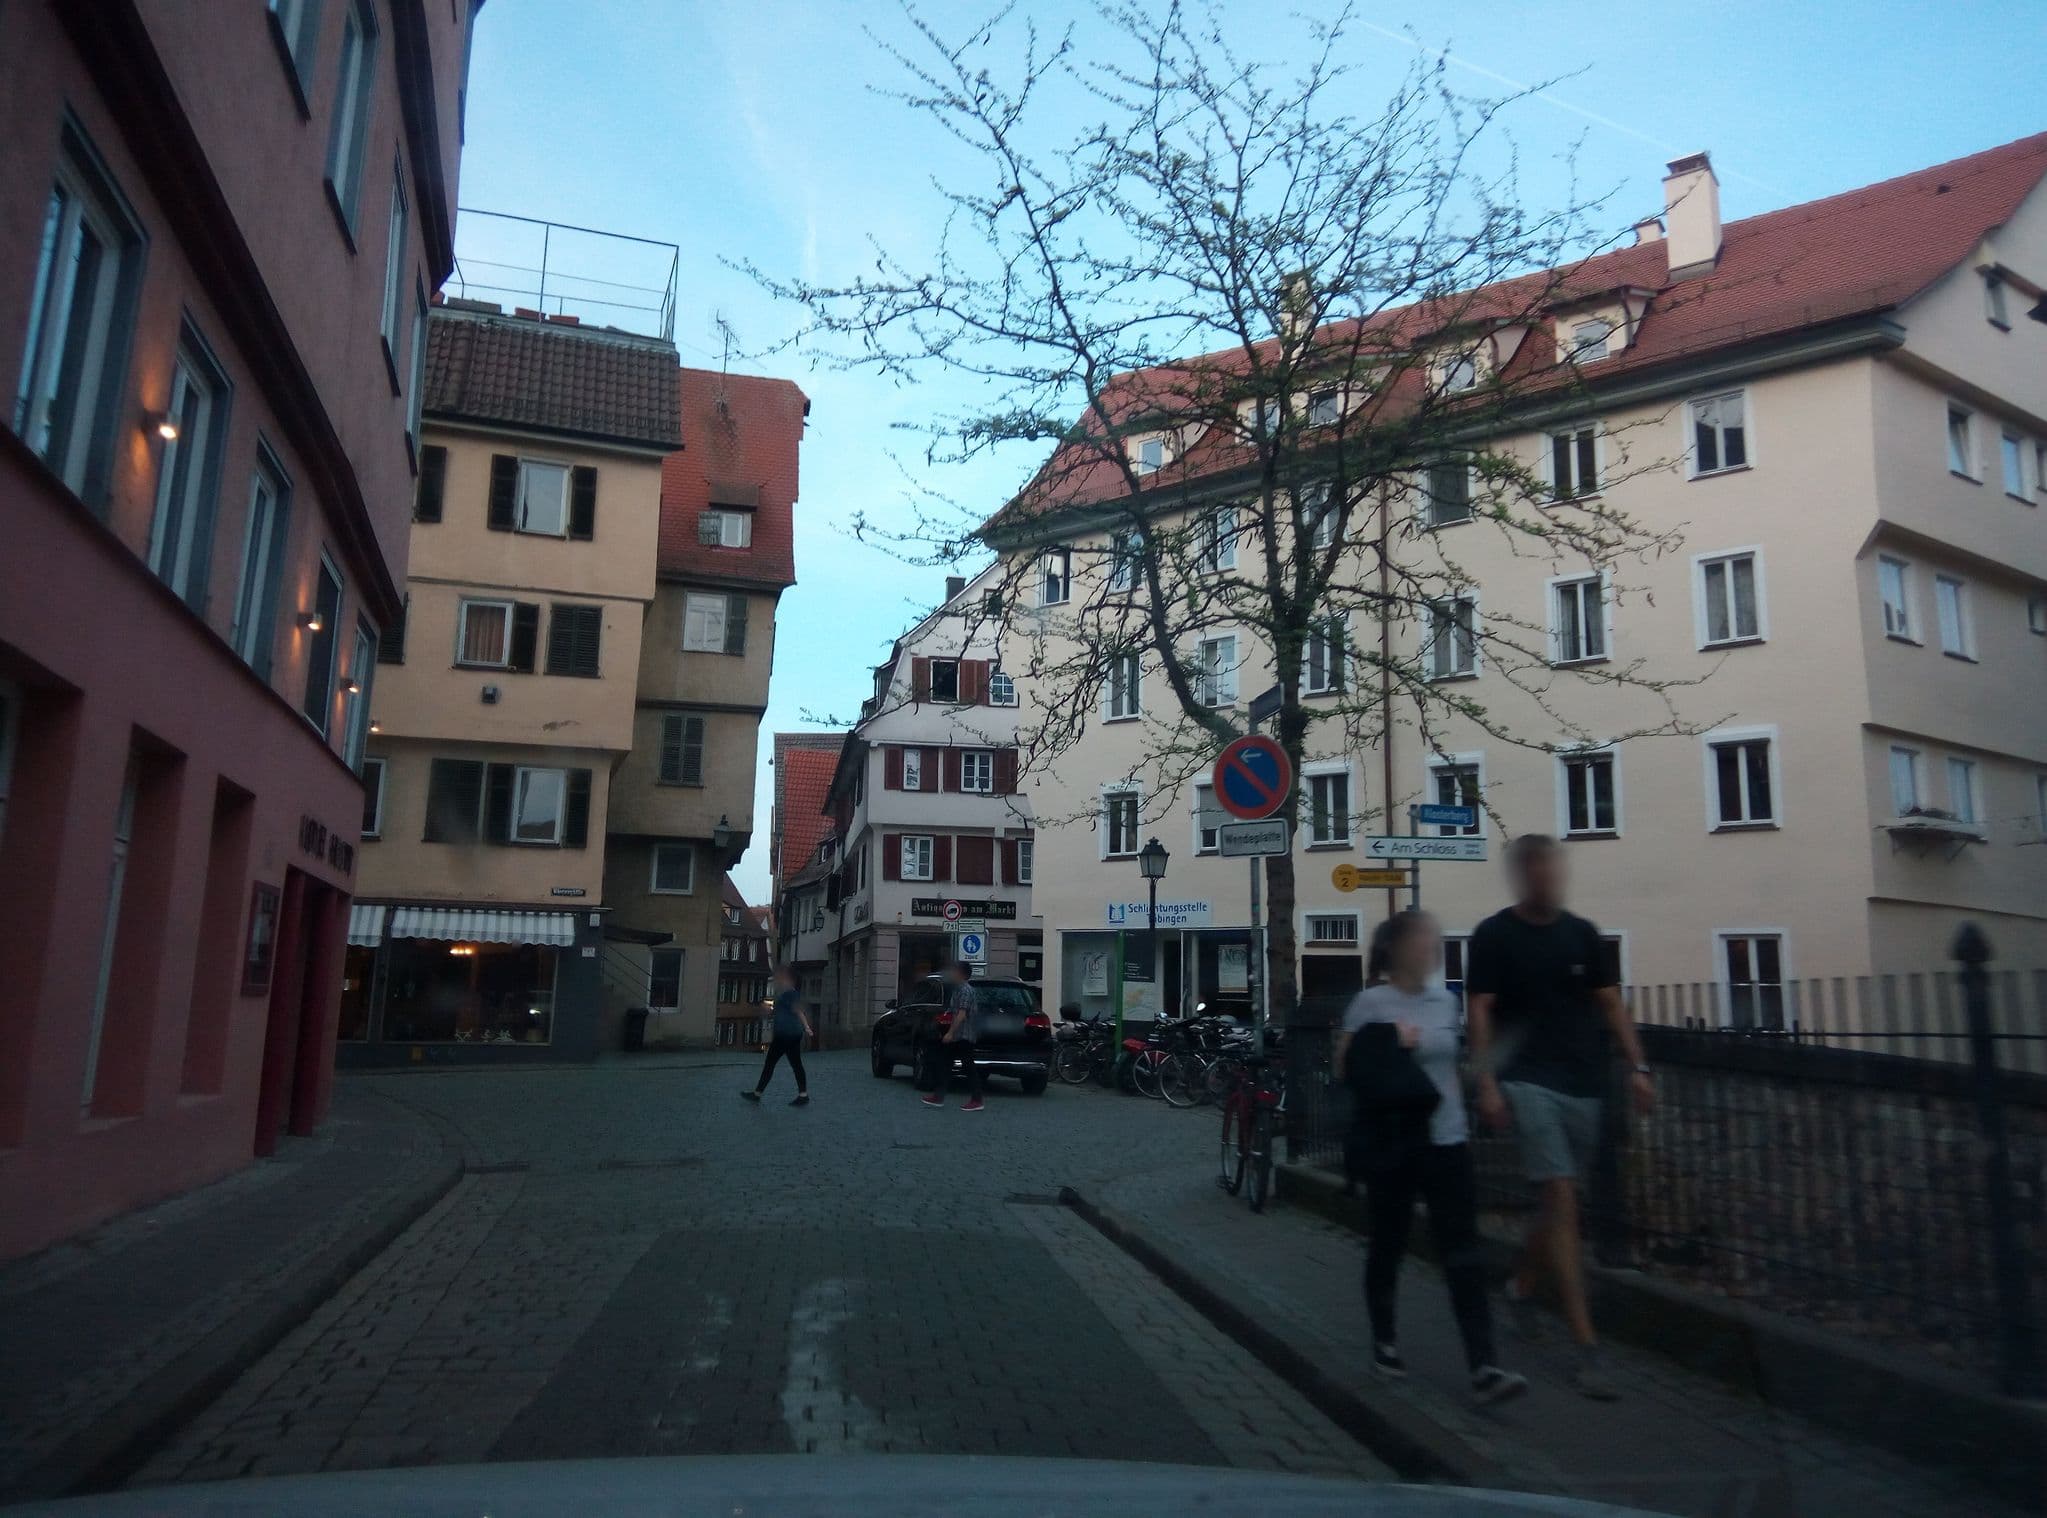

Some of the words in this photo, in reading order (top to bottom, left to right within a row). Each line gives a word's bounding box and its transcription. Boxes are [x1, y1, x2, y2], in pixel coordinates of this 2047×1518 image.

[1391, 842, 1412, 853] Am
[1414, 842, 1457, 855] Schloss
[1341, 877, 1350, 888] 2
[986, 902, 1015, 915] Markt
[1147, 913, 1187, 925] bingen
